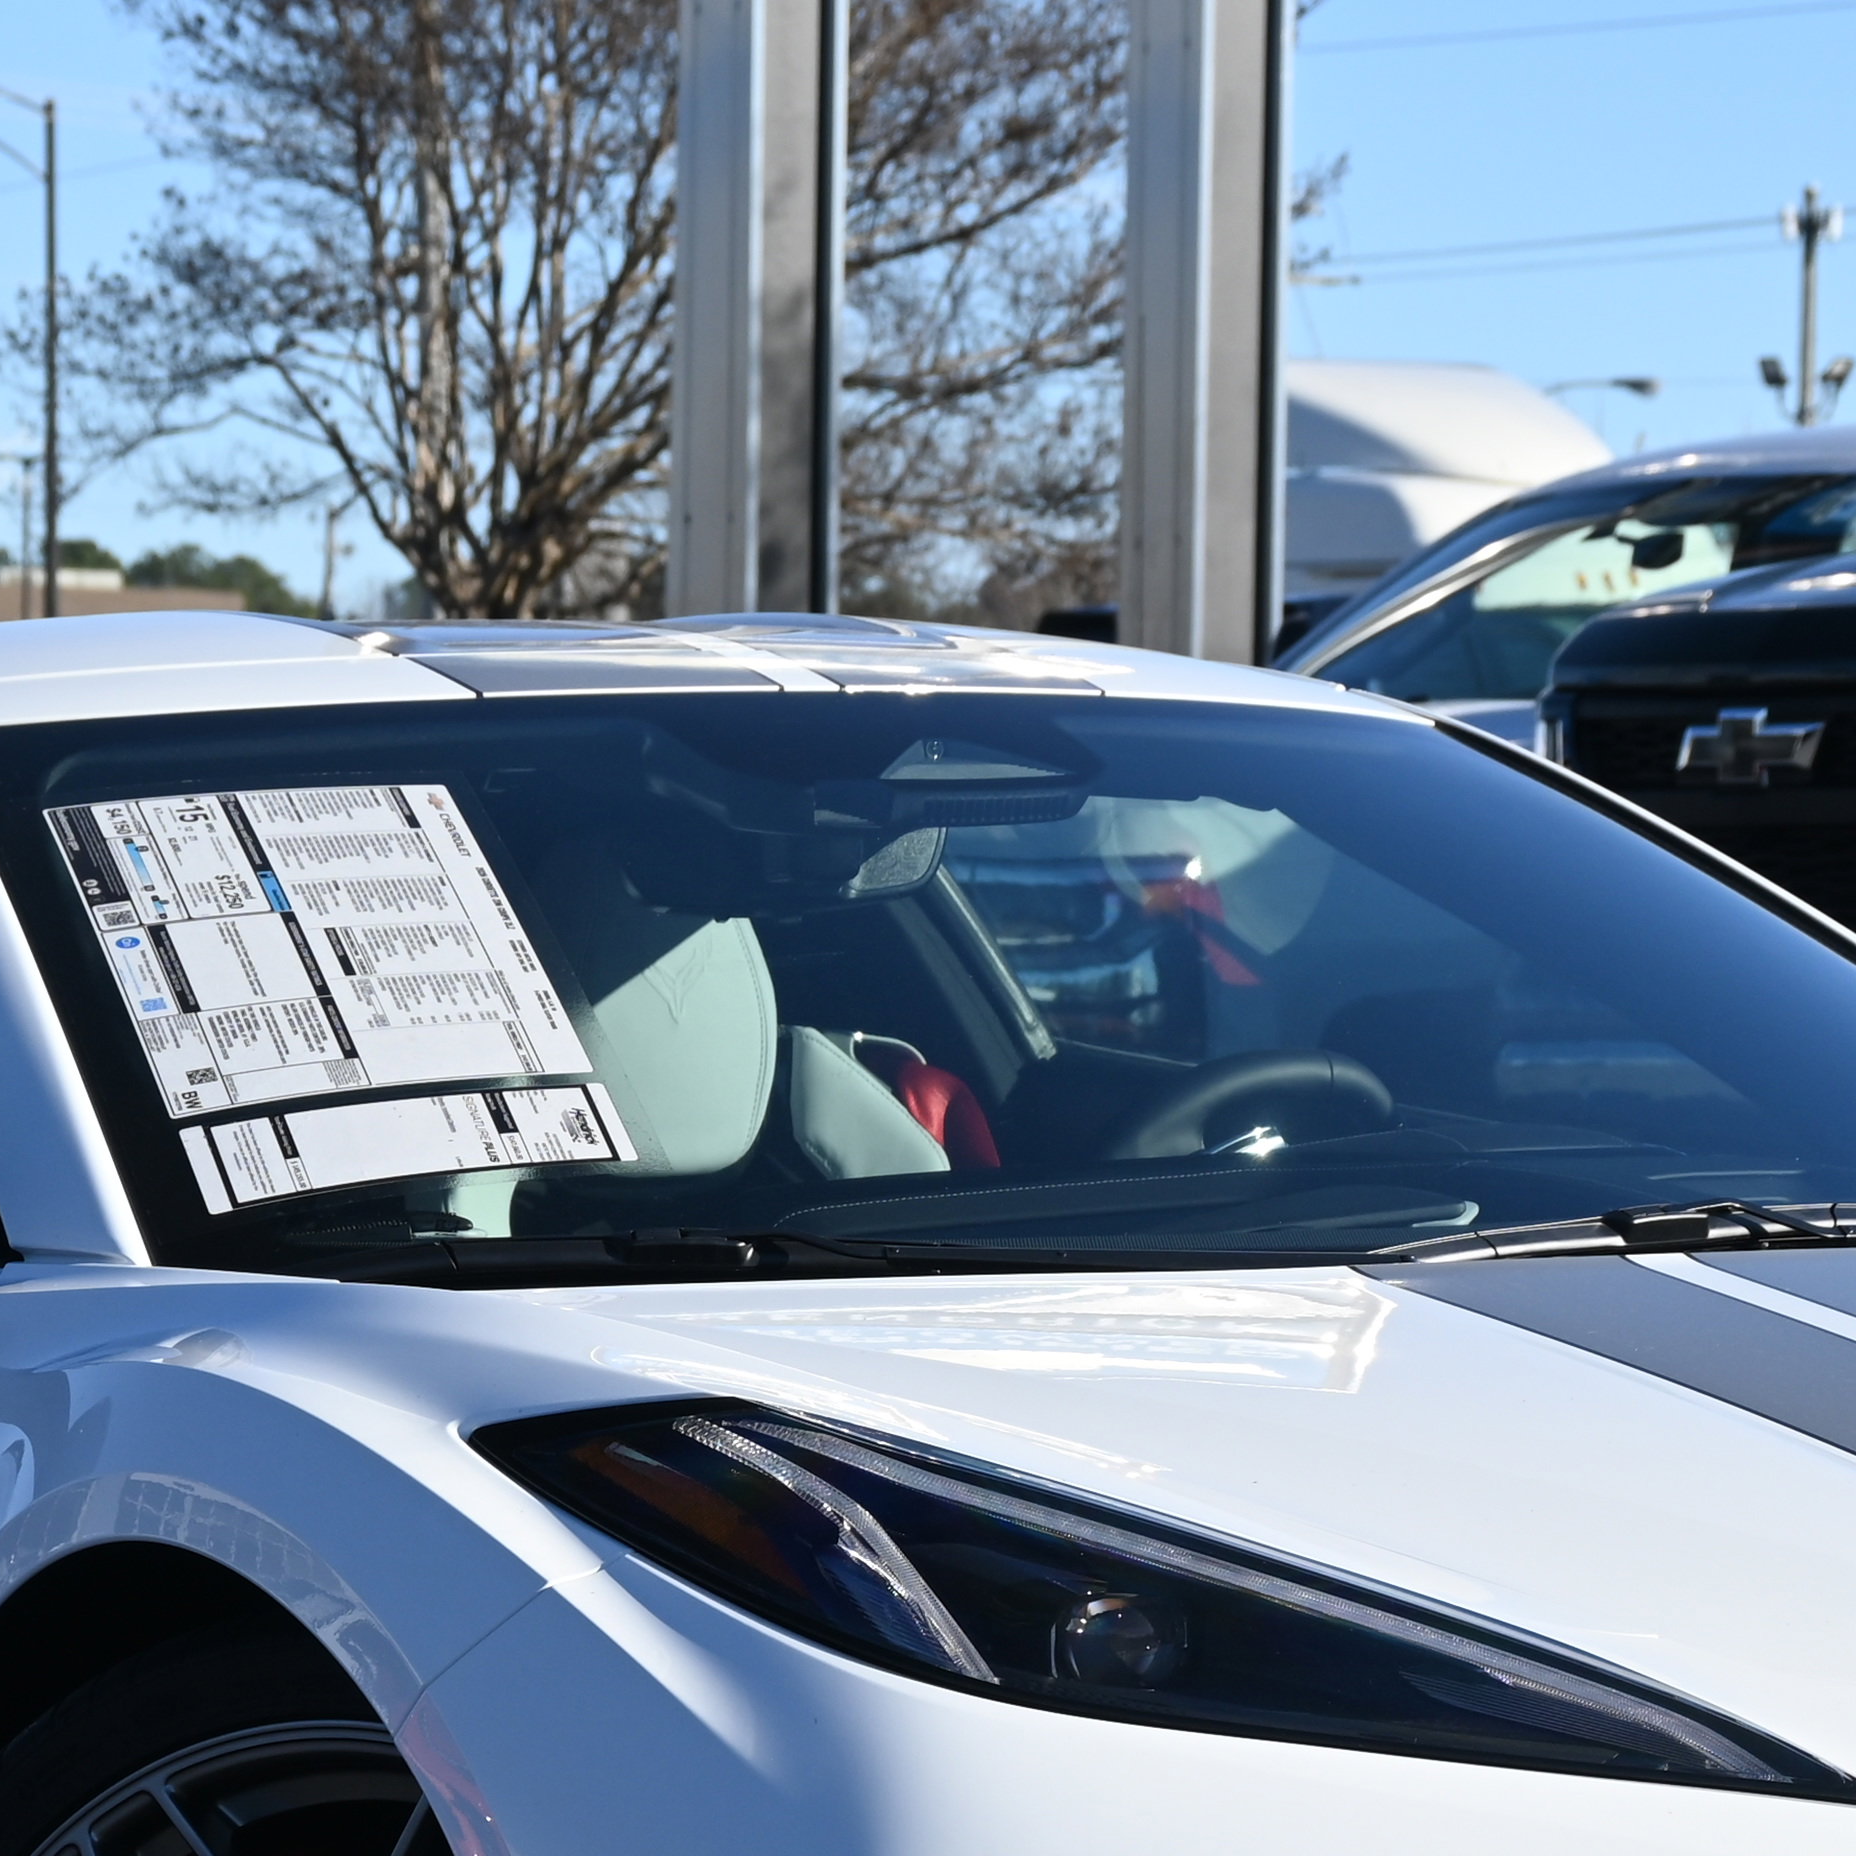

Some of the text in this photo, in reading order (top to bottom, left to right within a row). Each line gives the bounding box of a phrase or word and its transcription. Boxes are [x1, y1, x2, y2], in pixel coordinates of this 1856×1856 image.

[103, 807, 132, 835] $4,150
[173, 804, 209, 822] 15
[438, 812, 471, 857] CHEVROLET
[212, 874, 245, 909] $12,250
[179, 1090, 203, 1109] BW
[460, 1095, 492, 1142] SIGNATURE
[480, 1140, 500, 1163] PLUS
